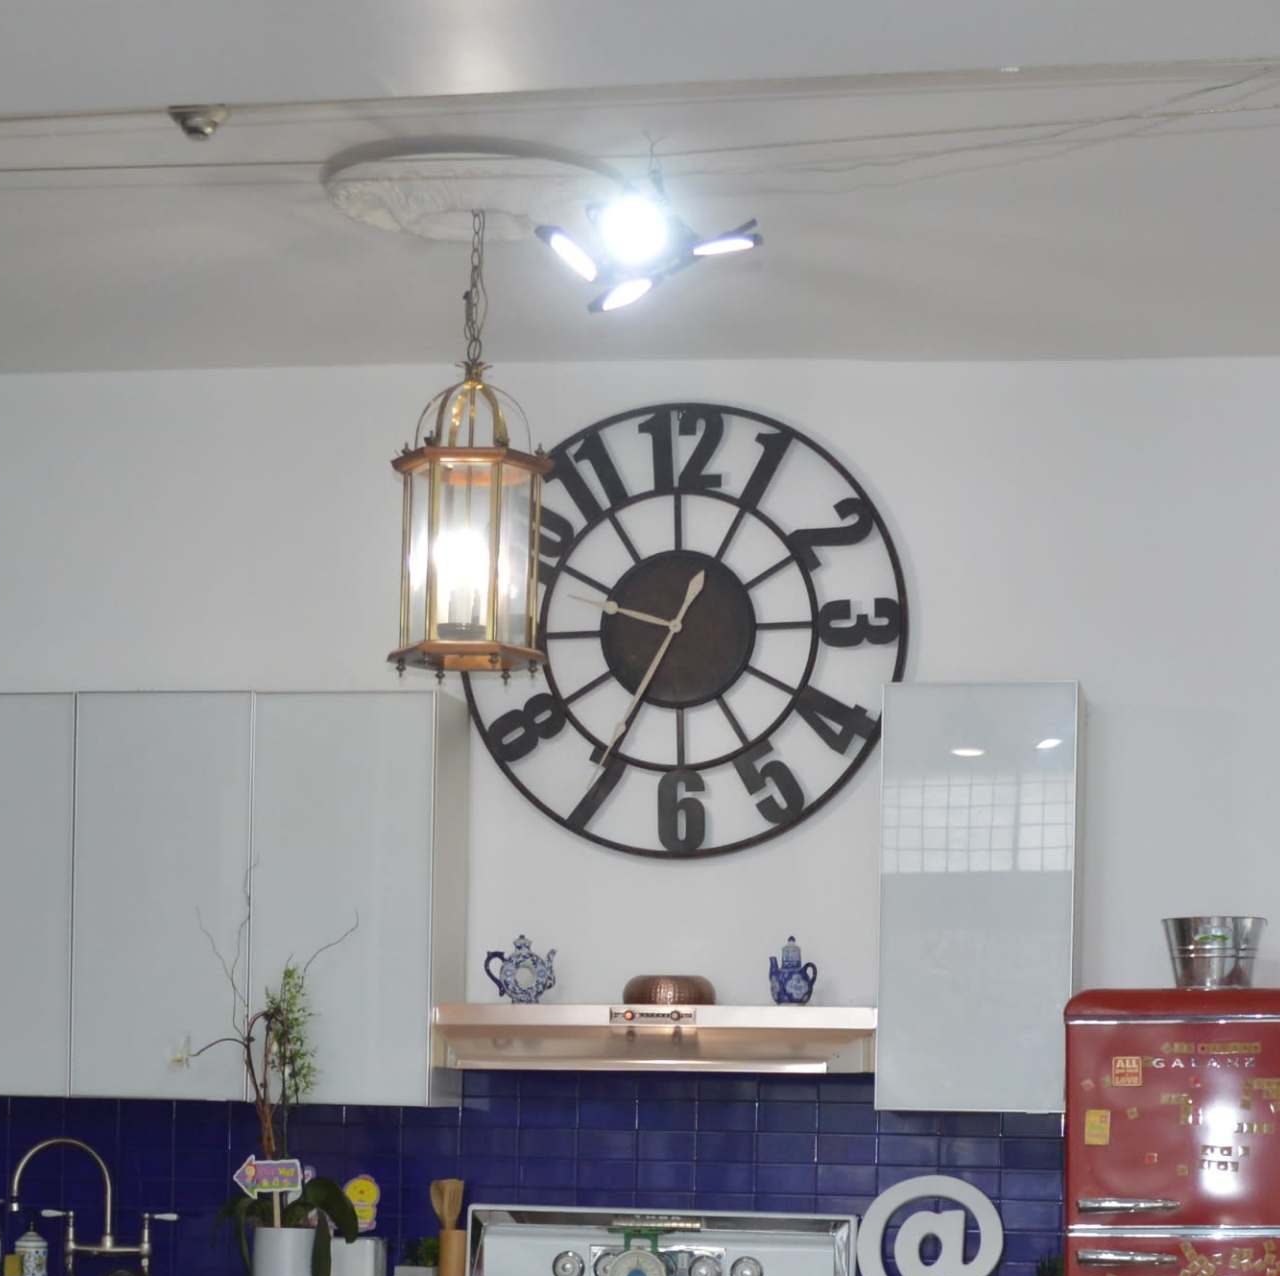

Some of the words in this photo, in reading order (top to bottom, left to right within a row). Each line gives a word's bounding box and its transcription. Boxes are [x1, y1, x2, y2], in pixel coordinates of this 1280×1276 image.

[545, 431, 628, 523] 11
[638, 408, 724, 490] 12
[739, 430, 794, 509] 1
[786, 497, 874, 572] 2
[819, 597, 900, 648] 3
[488, 692, 567, 763] 8
[796, 684, 878, 755] 4
[566, 746, 627, 830] 7
[658, 768, 706, 852] 6
[733, 738, 805, 824] 5
